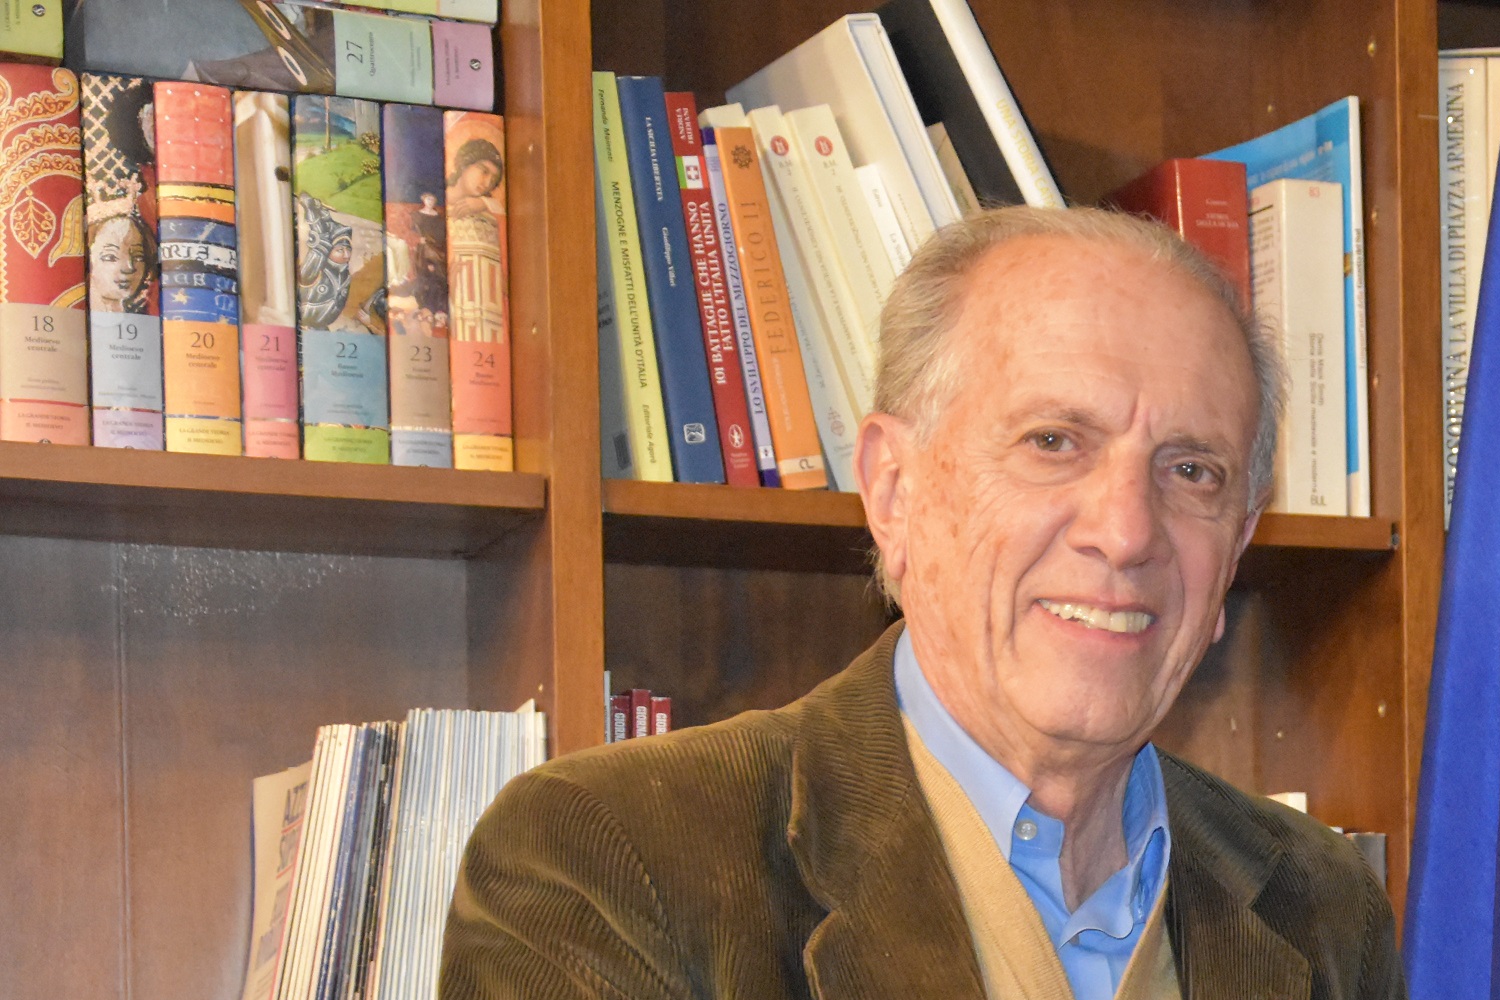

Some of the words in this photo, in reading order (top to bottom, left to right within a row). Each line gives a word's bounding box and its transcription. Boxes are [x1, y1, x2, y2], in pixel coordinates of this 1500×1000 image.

[343, 37, 365, 66] 27
[597, 87, 609, 126] Fernando
[646, 127, 658, 157] SICILIA
[1445, 82, 1467, 176] ARMERINA
[611, 180, 626, 238] MENZOGNE
[740, 199, 759, 222] II
[1447, 177, 1467, 241] PIAZZA
[684, 199, 706, 256] HANNO
[620, 246, 634, 291] MISFATTI
[717, 202, 743, 301] MEZZOGIORNO
[1449, 243, 1467, 263] DI
[694, 256, 711, 287] CHE
[705, 247, 726, 305] L'ITALIA
[746, 230, 787, 356] FEDERICO
[1450, 268, 1468, 318] VILLA
[32, 315, 55, 333] 18
[117, 323, 138, 341] 19
[626, 292, 643, 347] DELL'UNITÀ
[699, 288, 724, 363] BATTAGLIE
[715, 305, 735, 352] FATTO
[734, 302, 748, 329] DEL
[1451, 319, 1467, 344] LA
[190, 331, 215, 349] 20
[260, 334, 281, 352] 21
[336, 341, 358, 359] 22
[410, 345, 433, 362] 23
[473, 351, 496, 368] 24
[634, 348, 648, 388] D'ITALIA
[739, 330, 760, 394] SVILUPPO
[751, 395, 764, 415] LO
